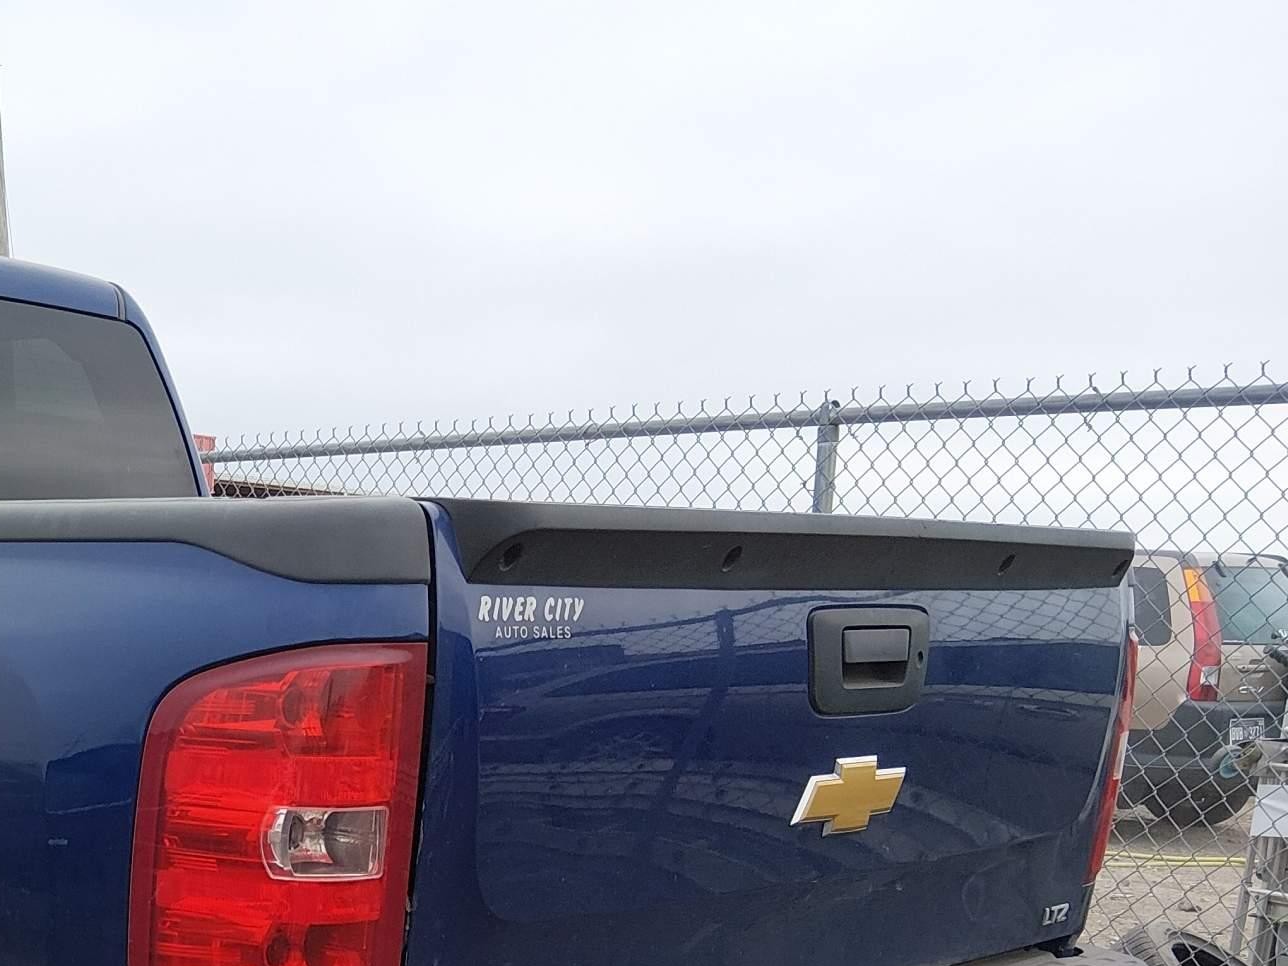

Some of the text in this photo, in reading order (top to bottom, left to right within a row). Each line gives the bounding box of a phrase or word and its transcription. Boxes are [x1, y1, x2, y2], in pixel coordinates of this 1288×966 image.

[478, 595, 585, 622] RIVER CITY
[495, 625, 571, 639] AUTO SALES
[1042, 902, 1070, 926] LTZ
